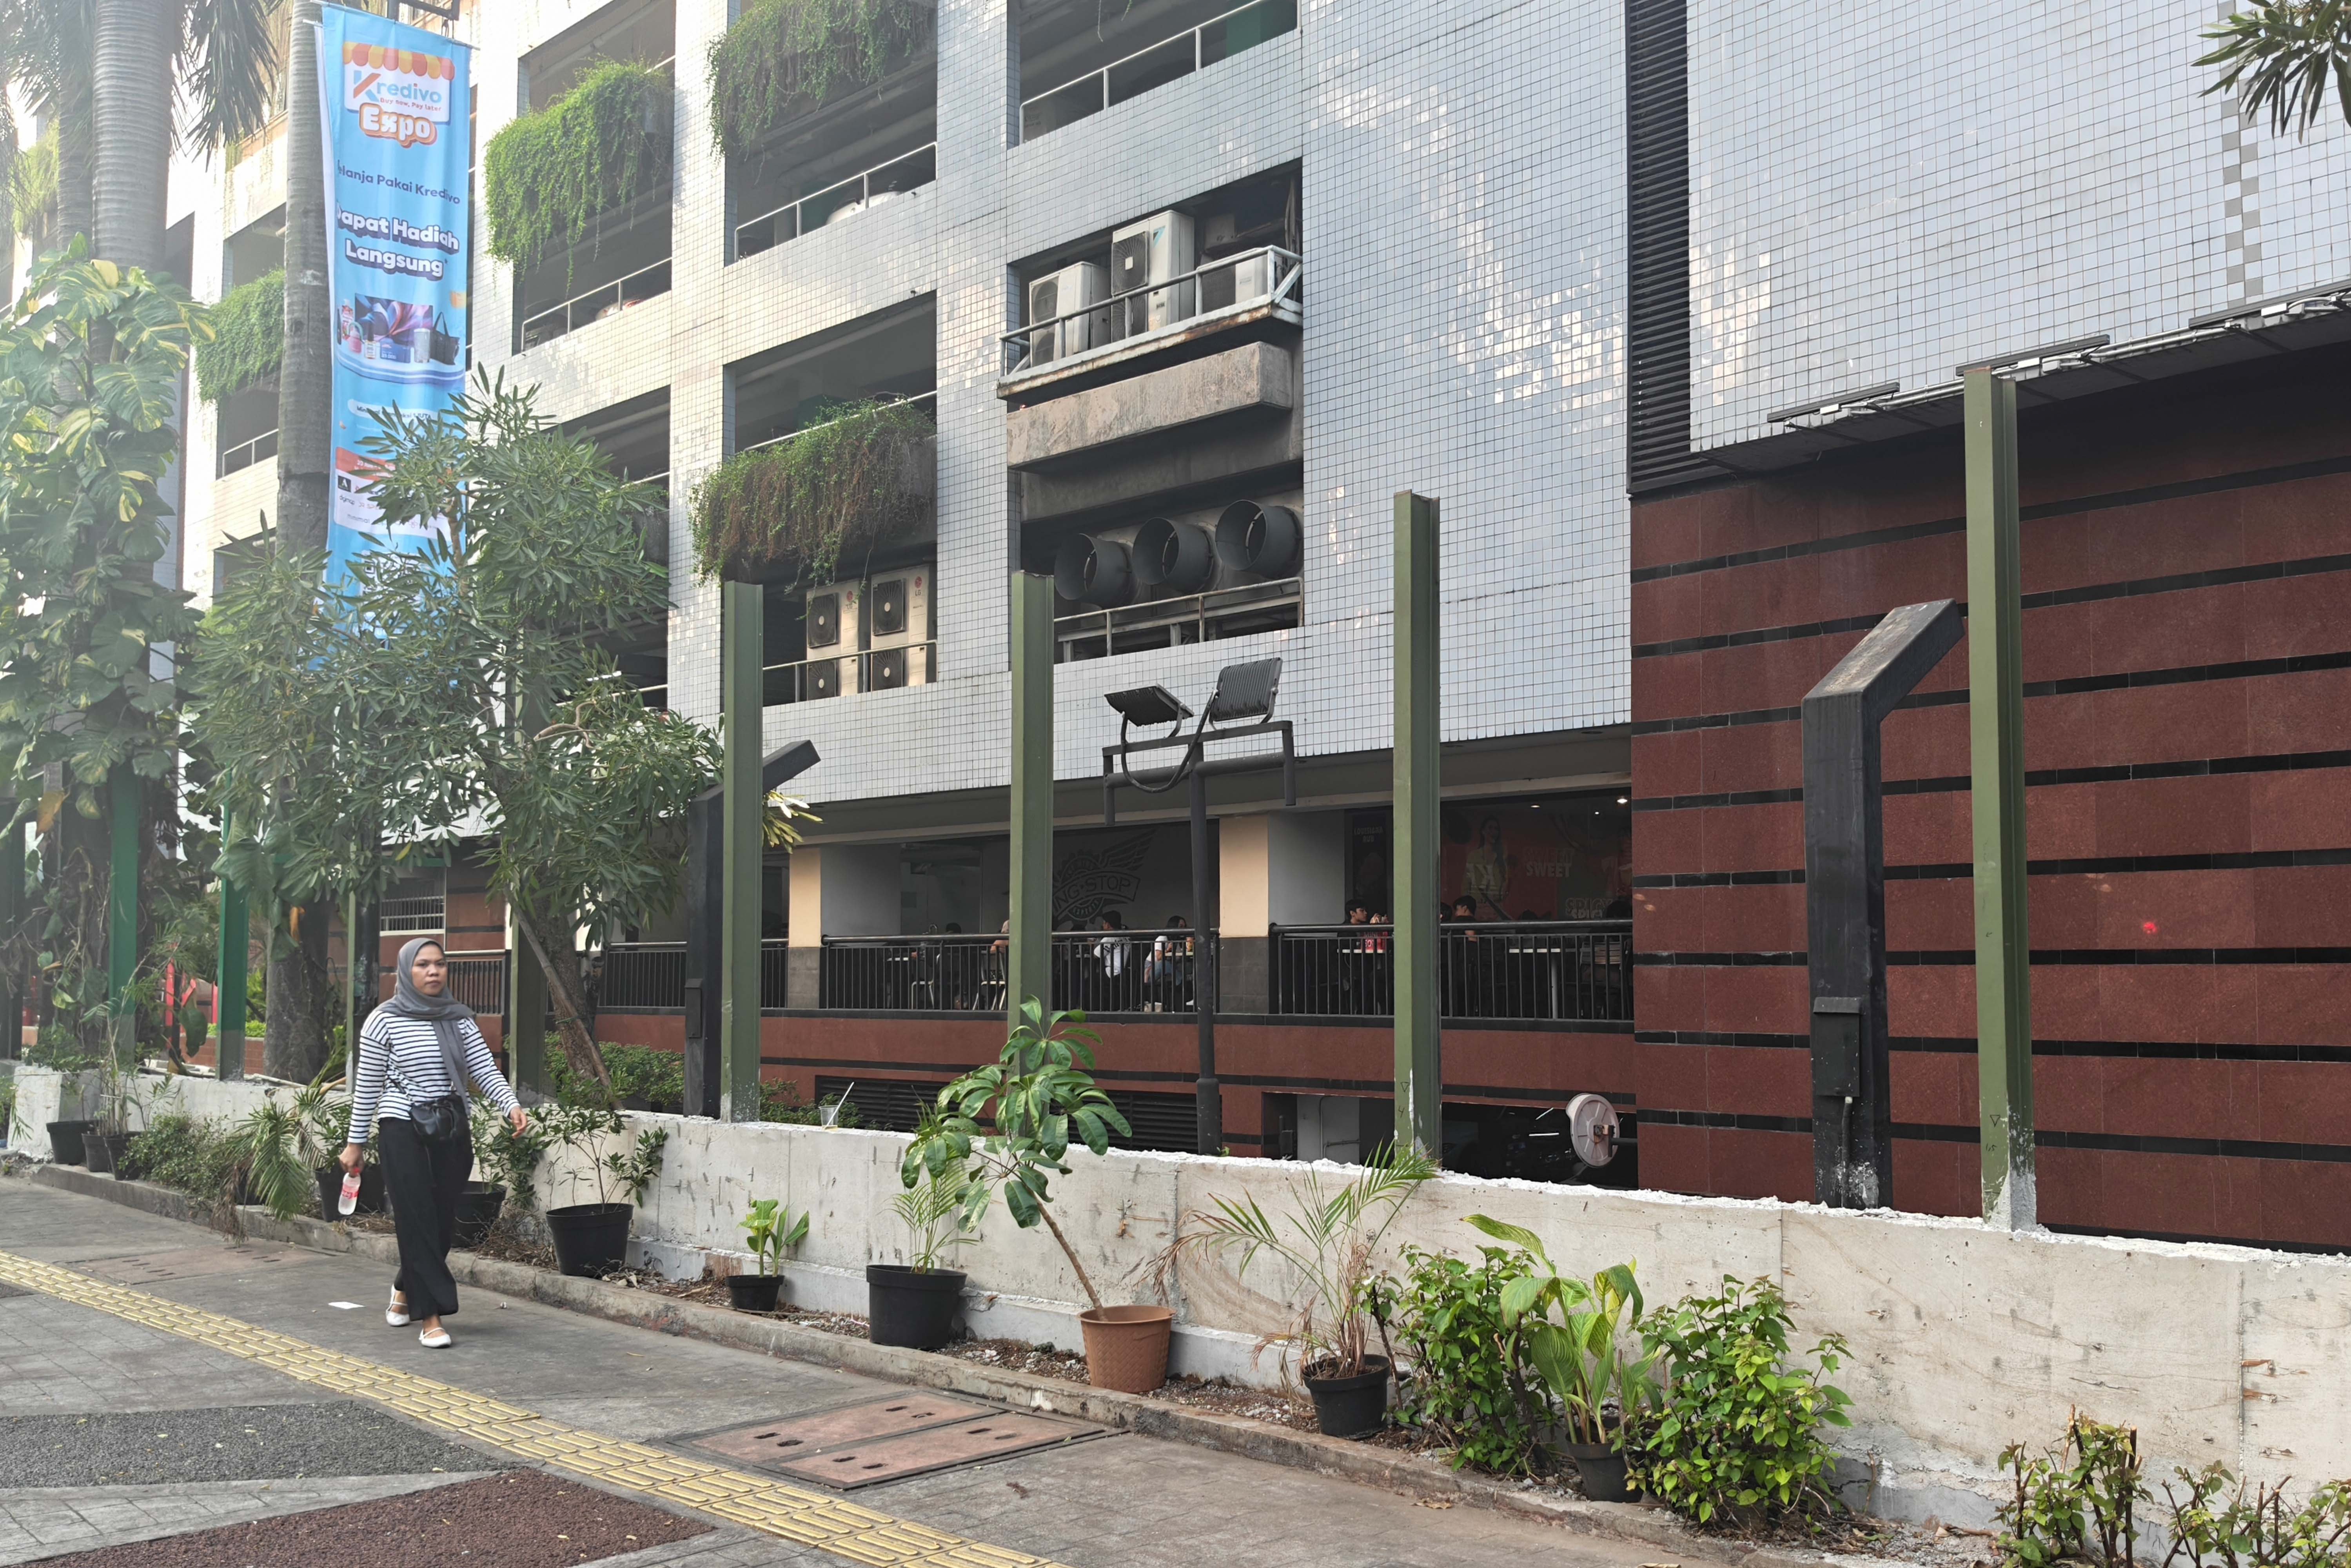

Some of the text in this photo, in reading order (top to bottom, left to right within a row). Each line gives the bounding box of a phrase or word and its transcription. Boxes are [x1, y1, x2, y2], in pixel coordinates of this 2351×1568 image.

[354, 70, 442, 103] Kredivo
[362, 106, 431, 142] Expo
[338, 160, 460, 204] elanja Pakai Kredivo
[393, 218, 459, 250] Hadiah
[1525, 861, 1572, 878] SWEET
